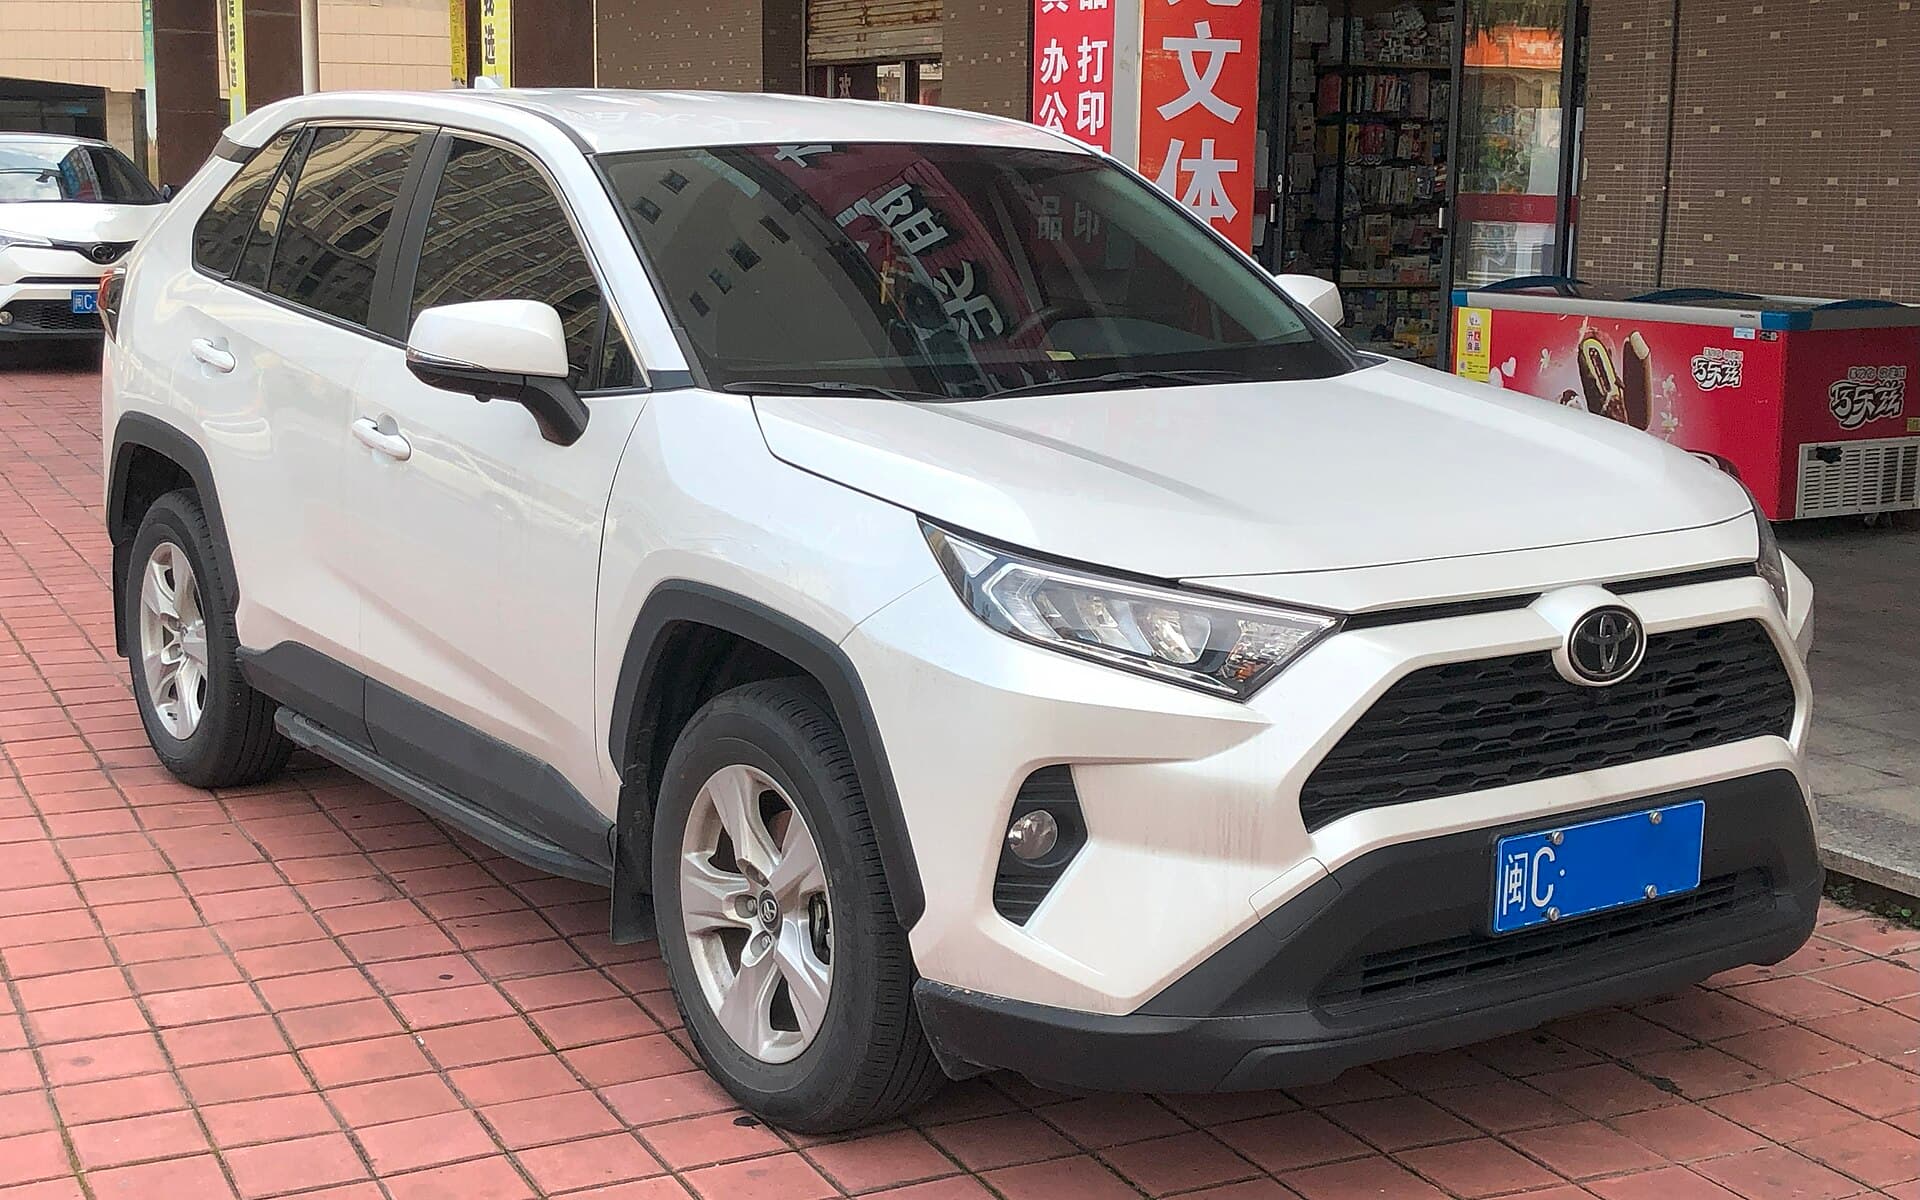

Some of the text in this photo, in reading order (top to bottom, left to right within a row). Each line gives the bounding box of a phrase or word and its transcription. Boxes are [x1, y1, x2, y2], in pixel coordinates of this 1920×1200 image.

[1077, 35, 1108, 152] 打印
[1156, 0, 1242, 224] 文体
[1829, 380, 1905, 429] 巧乐兹
